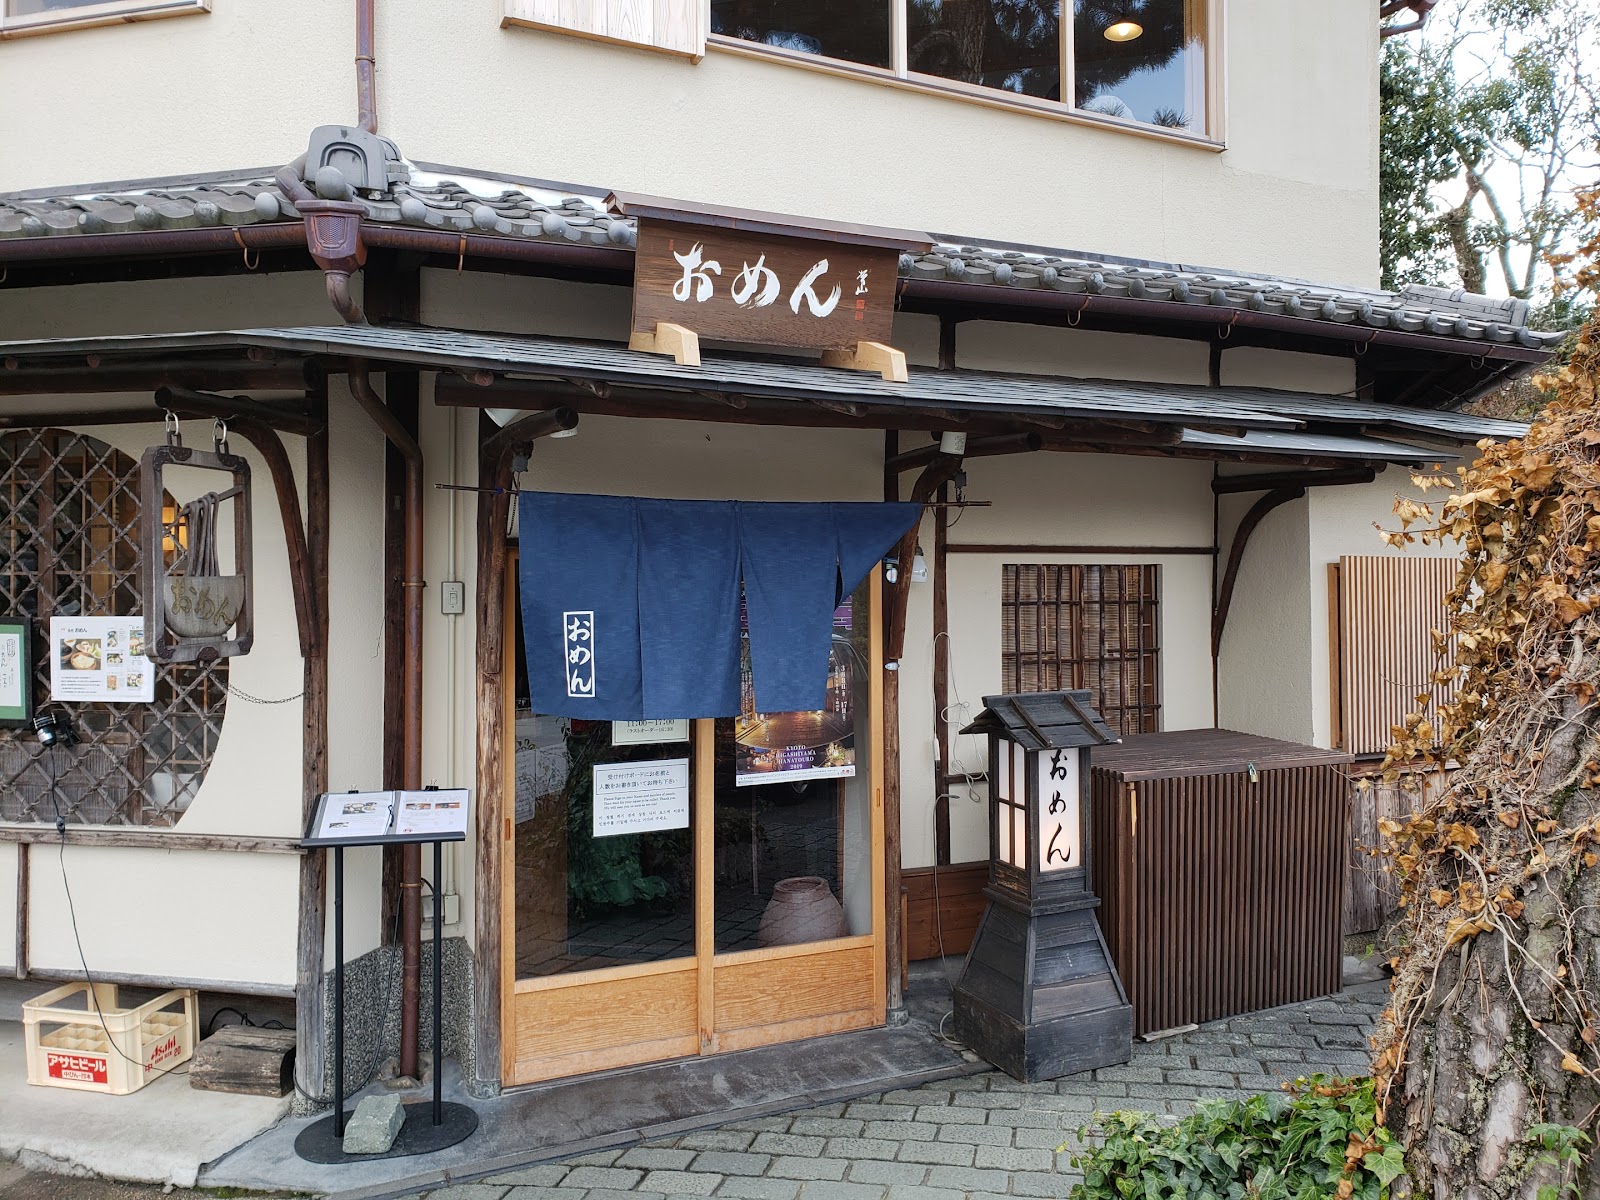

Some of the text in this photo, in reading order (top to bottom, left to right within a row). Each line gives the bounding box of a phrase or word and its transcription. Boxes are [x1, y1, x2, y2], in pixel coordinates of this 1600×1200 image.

[673, 241, 841, 317] おめん
[171, 578, 239, 626] おめん
[568, 616, 592, 692] おめん
[1047, 749, 1071, 865] おめん
[48, 1055, 106, 1073] アサヒビール
[150, 1034, 176, 1061] Asahi
